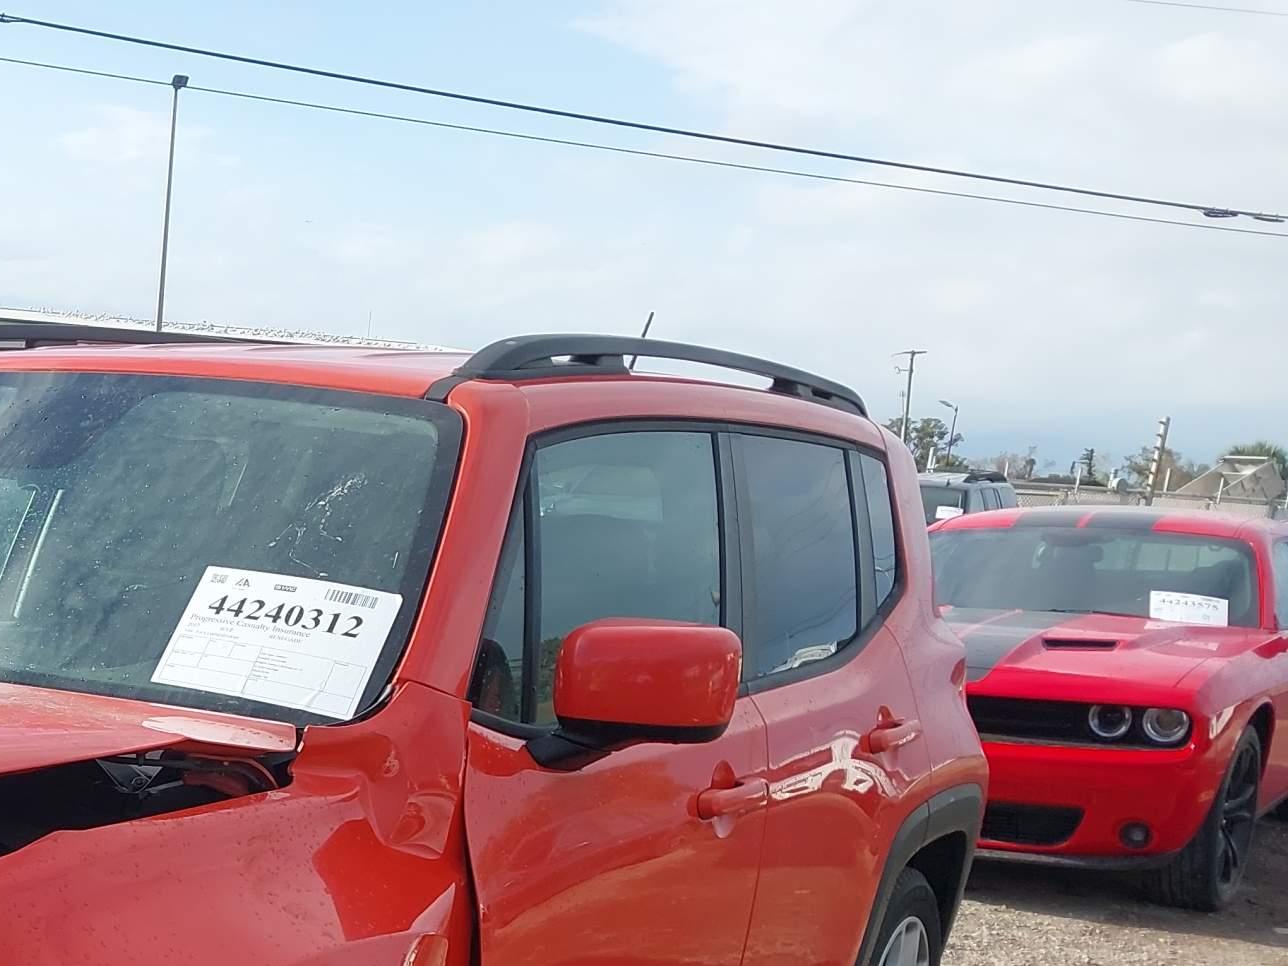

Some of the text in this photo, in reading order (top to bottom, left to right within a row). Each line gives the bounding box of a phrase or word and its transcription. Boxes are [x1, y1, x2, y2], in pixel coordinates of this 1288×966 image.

[189, 613, 235, 626] Progressive
[236, 620, 270, 632] Casualty
[271, 625, 311, 637] Insurance
[208, 594, 364, 638] 44240312
